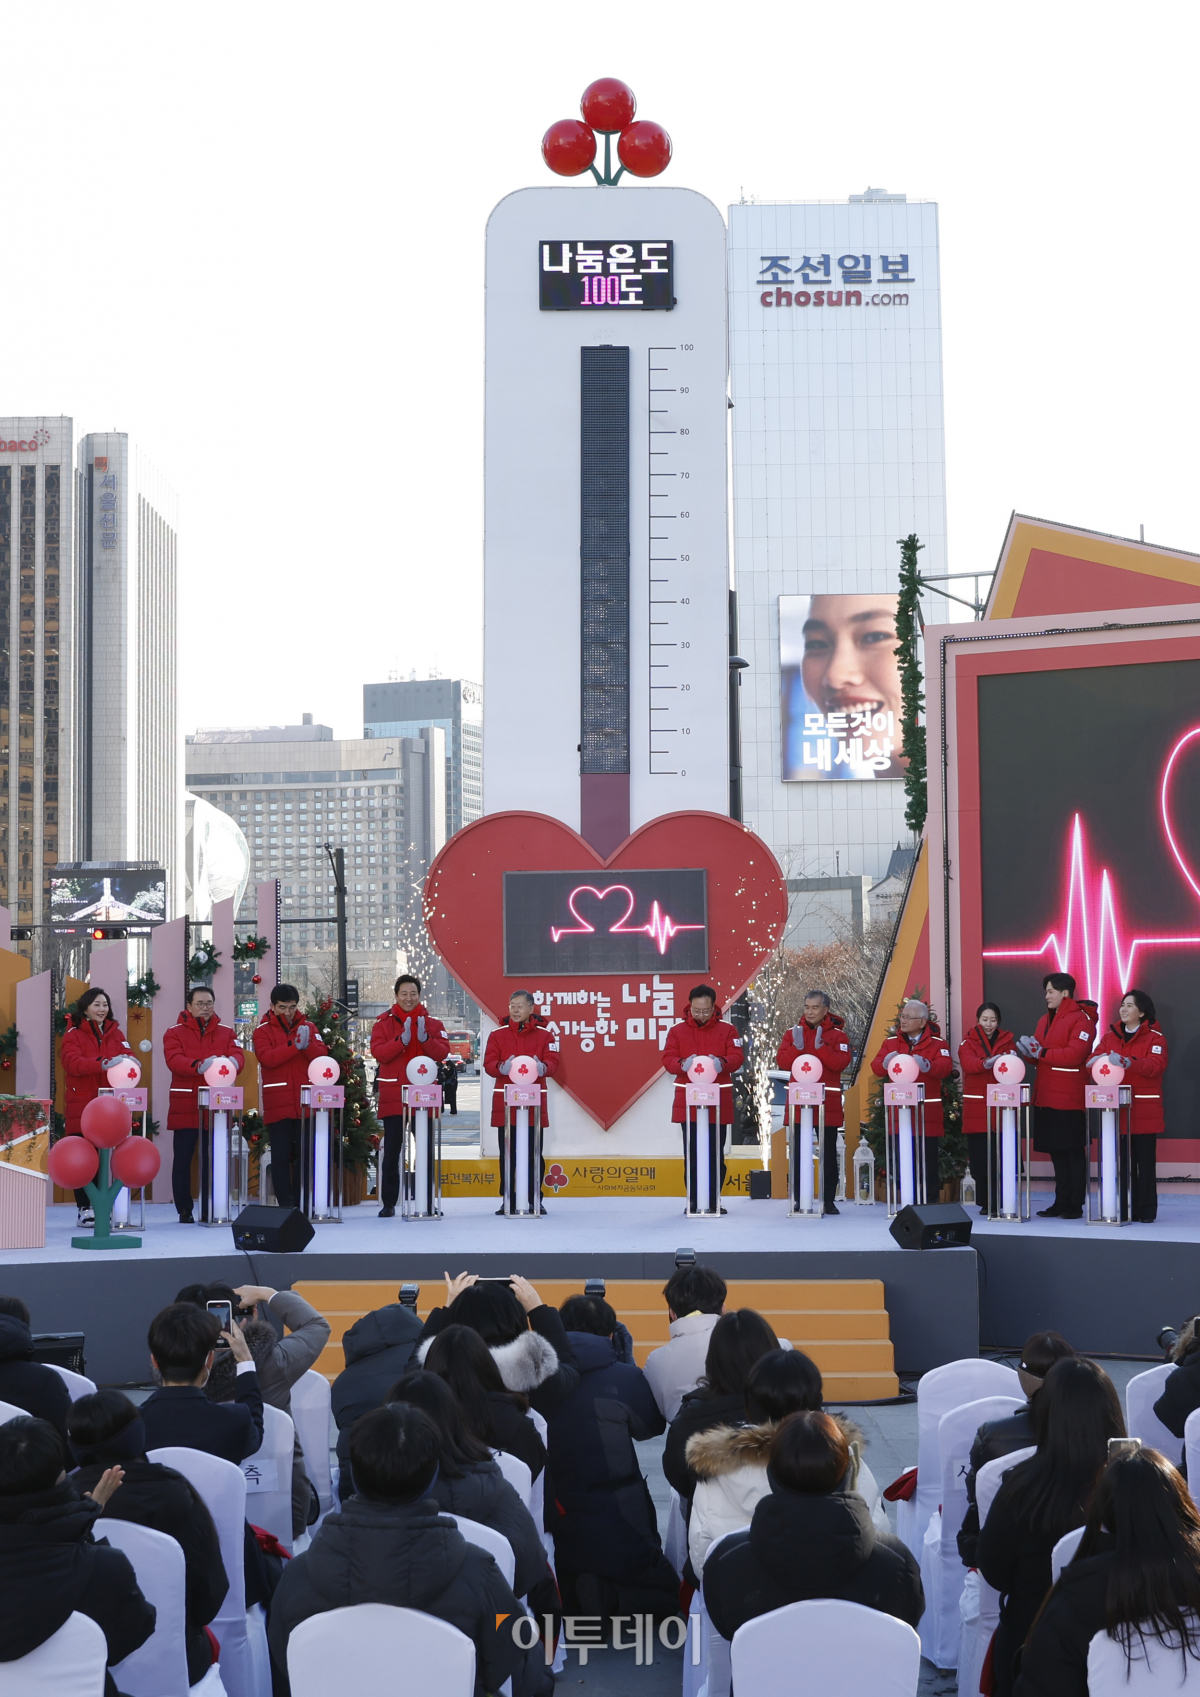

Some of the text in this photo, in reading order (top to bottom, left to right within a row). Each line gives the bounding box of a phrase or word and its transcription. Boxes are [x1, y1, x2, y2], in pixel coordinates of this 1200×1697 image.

[542, 242, 669, 273] 나눔온도
[756, 253, 916, 284] 조선일보
[580, 274, 644, 305] 100도
[760, 287, 909, 307] chosun.com
[100, 474, 117, 549] 서울신문
[680, 511, 690, 519] 60
[680, 554, 690, 562] 50
[680, 641, 690, 649] 30
[532, 974, 674, 1017] 함께하는 나눔
[440, 1172, 495, 1185] 보건복지부
[572, 1166, 656, 1184] 사랑의열매
